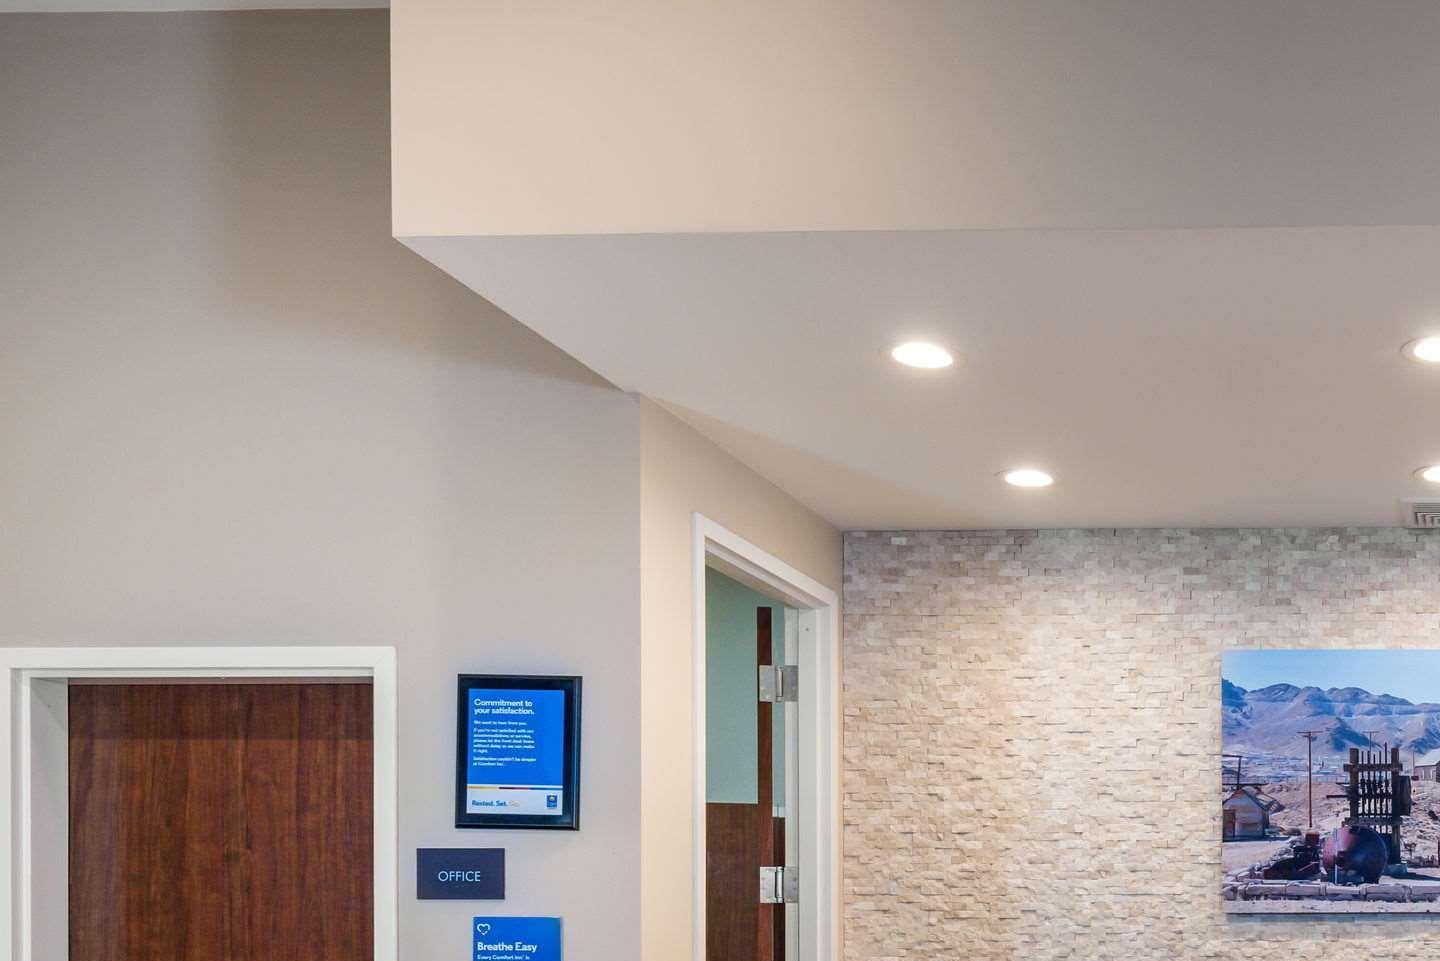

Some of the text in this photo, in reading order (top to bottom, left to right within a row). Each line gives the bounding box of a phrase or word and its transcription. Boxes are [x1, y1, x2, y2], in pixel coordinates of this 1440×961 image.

[474, 698, 523, 707] Commitment
[492, 707, 535, 715] satisfaction.
[438, 870, 481, 882] OFFICE
[477, 941, 538, 953] Breathe Easy
